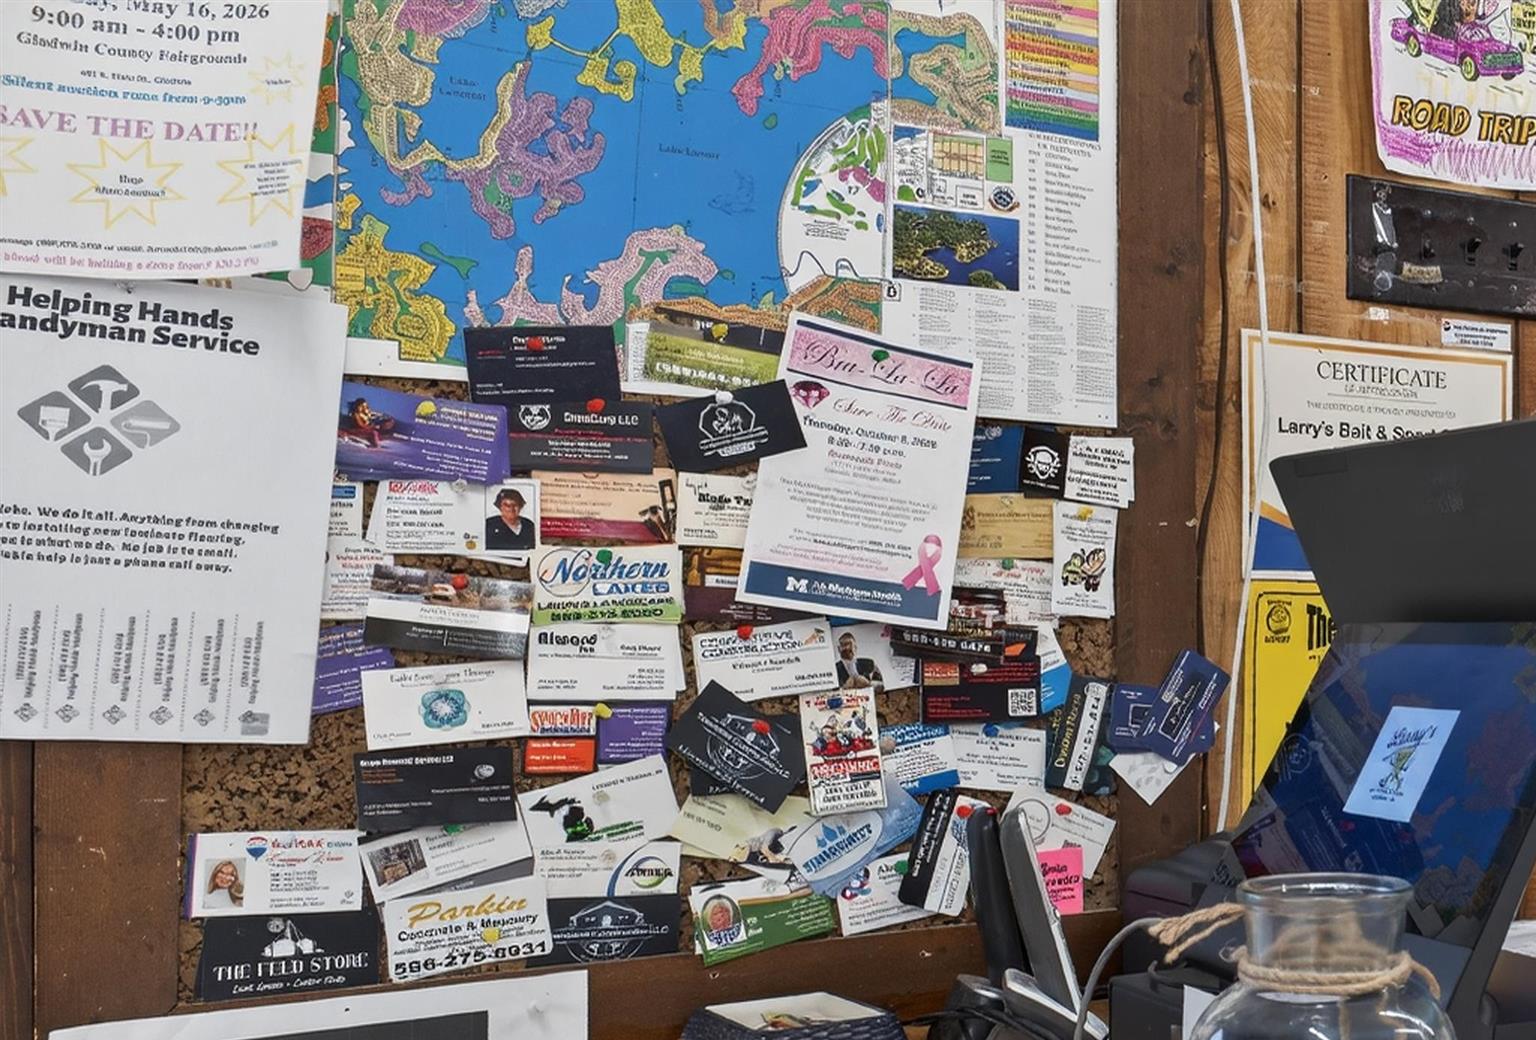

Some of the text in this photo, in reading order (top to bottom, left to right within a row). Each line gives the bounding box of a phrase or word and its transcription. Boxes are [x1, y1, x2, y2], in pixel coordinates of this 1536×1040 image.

[32, 5, 84, 29] 9:00
[91, 19, 127, 35] am
[152, 24, 200, 41] 4:00
[207, 29, 240, 46] pm
[188, 3, 217, 20] 16,
[223, 4, 269, 19] 2026
[94, 42, 153, 62] County
[87, 115, 154, 139] THE
[163, 121, 258, 142] DATE!!
[1392, 96, 1472, 136] ROAD
[8, 286, 234, 331] Helping Hands
[153, 326, 260, 355] Service
[1316, 360, 1448, 390] CERTIFICATE
[1278, 417, 1334, 438] Larry's
[1340, 422, 1372, 441] Bait
[1376, 425, 1388, 439] &
[213, 963, 252, 982] THE
[310, 952, 369, 971] STORE
